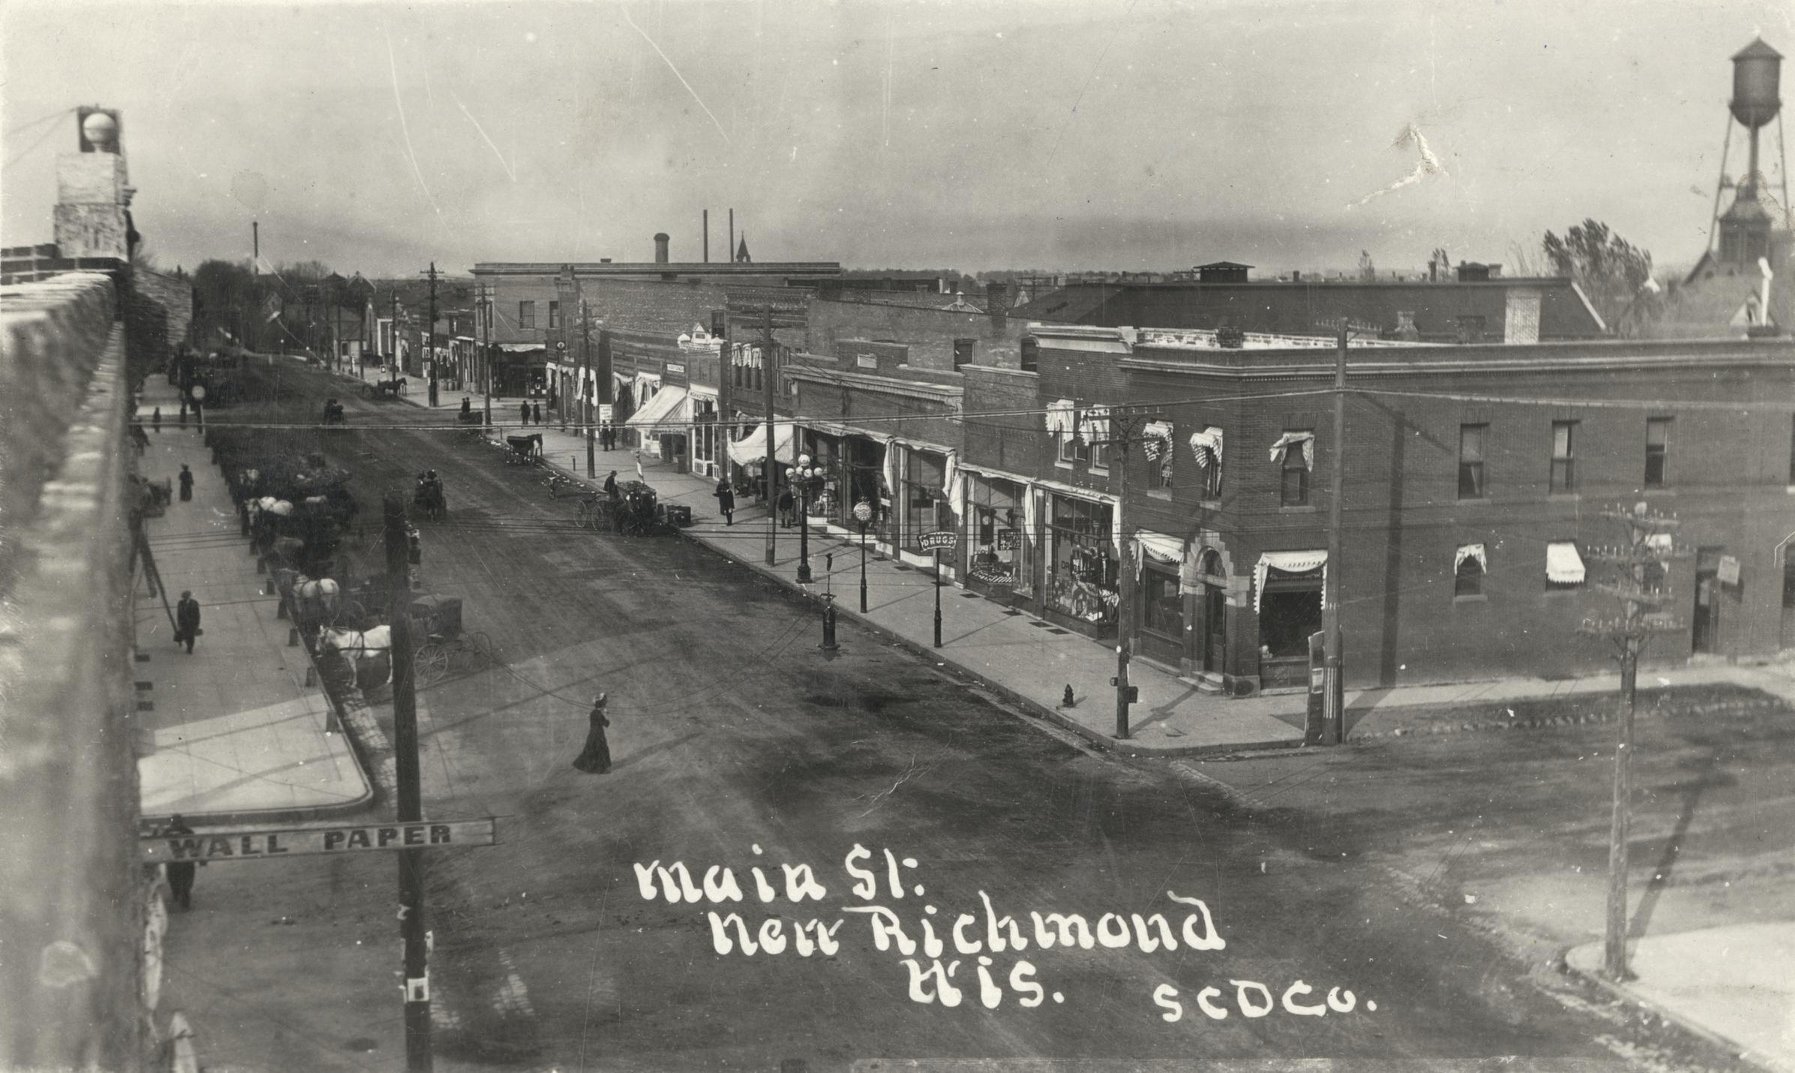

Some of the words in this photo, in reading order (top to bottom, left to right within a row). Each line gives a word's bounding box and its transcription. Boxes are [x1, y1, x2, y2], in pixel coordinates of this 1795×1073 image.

[922, 536, 954, 546] DRUGS
[169, 834, 289, 859] WALL
[323, 824, 453, 851] PAPER
